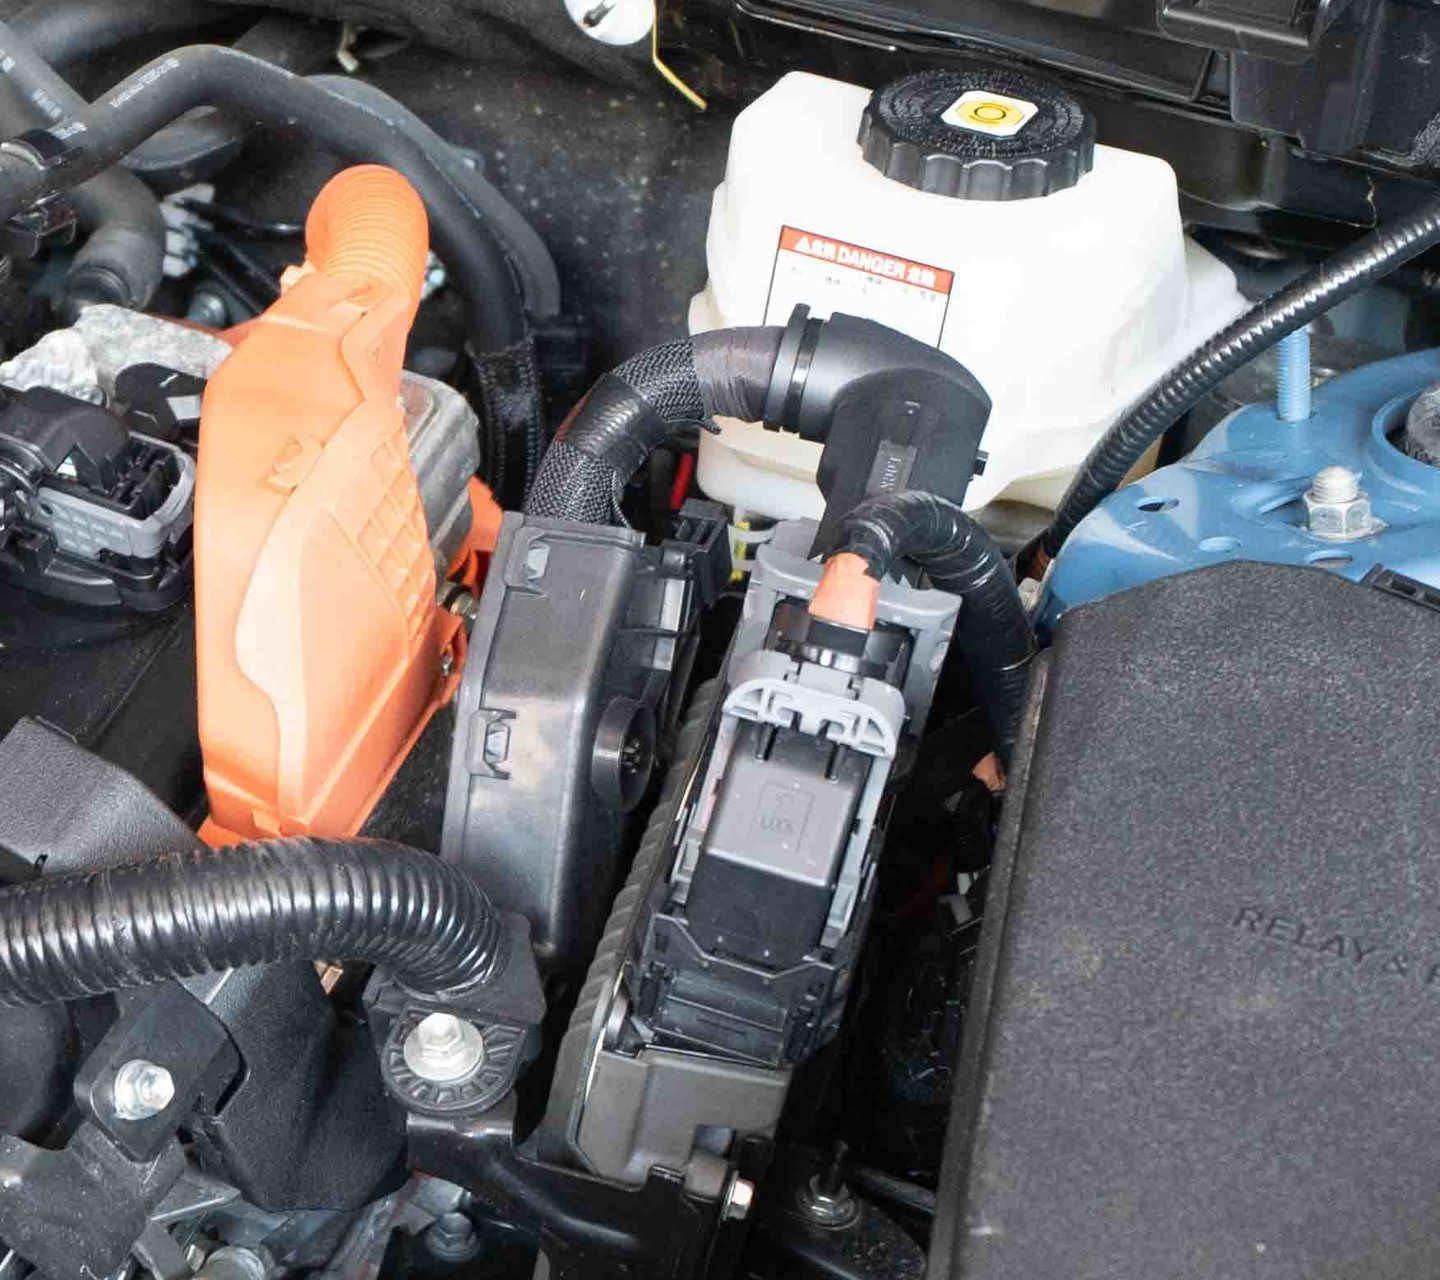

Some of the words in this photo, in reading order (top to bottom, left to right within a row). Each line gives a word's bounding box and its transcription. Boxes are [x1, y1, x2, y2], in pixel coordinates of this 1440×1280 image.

[837, 247, 906, 279] DANGER
[1233, 906, 1376, 963] RELAY
[1382, 954, 1411, 977] &
